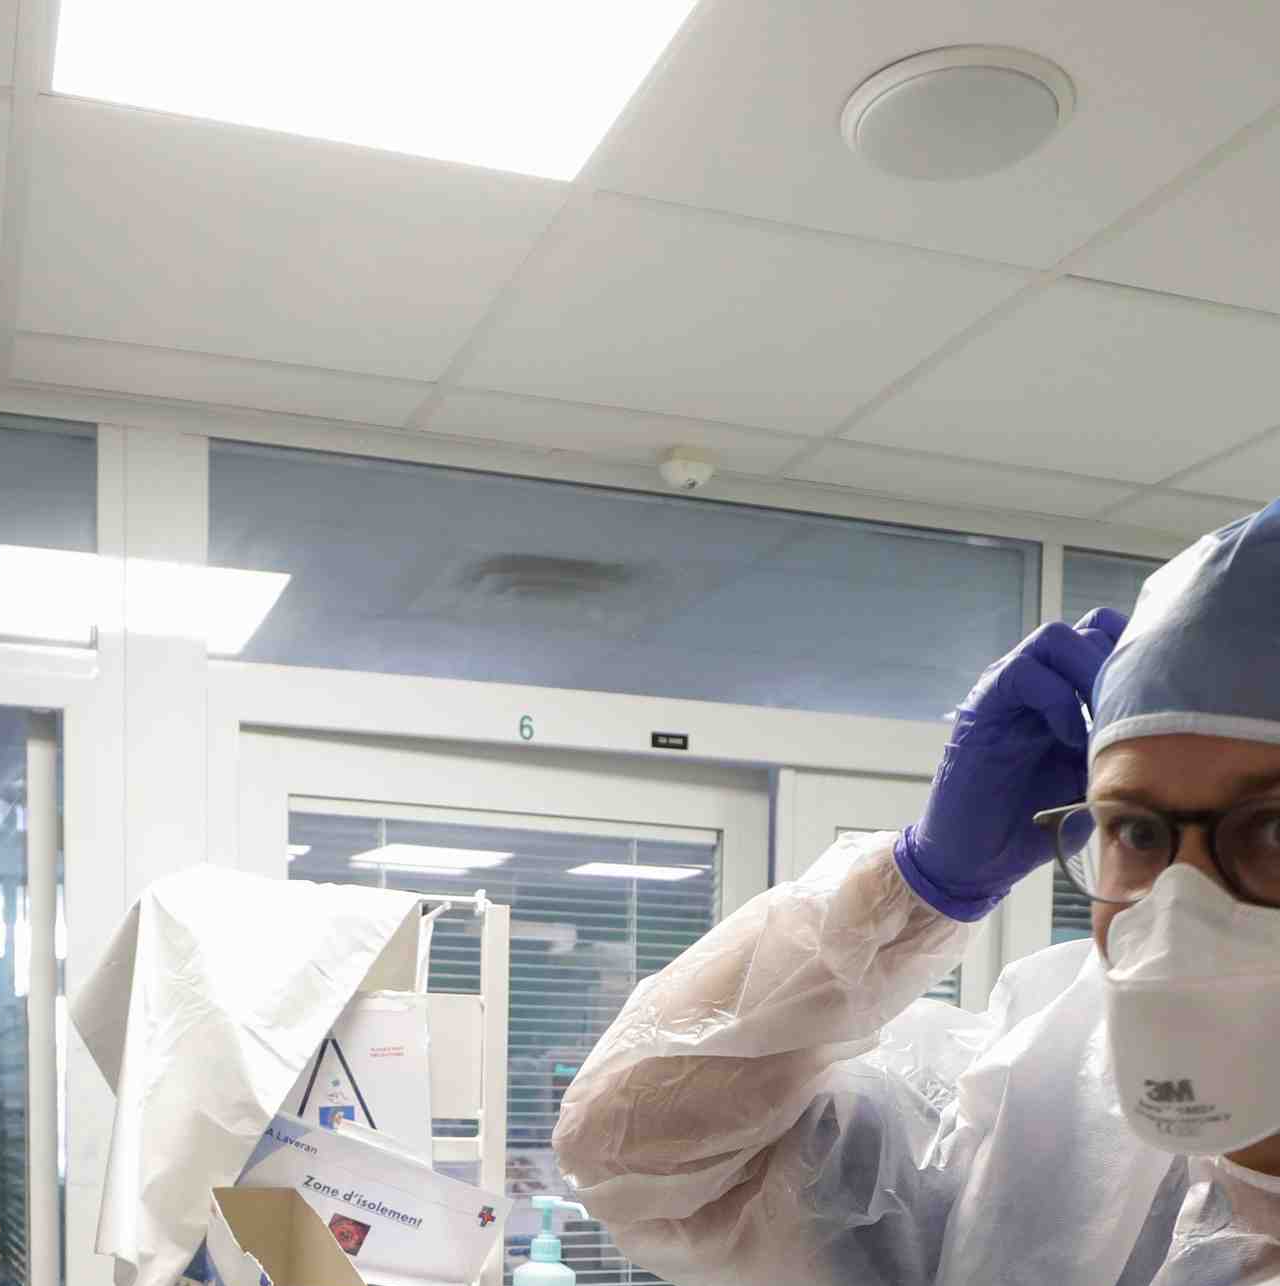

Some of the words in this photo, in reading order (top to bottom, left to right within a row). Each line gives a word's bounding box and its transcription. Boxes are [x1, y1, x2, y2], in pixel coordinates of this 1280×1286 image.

[519, 715, 534, 741] 6
[1144, 1080, 1195, 1102] 3M
[303, 1175, 339, 1197] Zone
